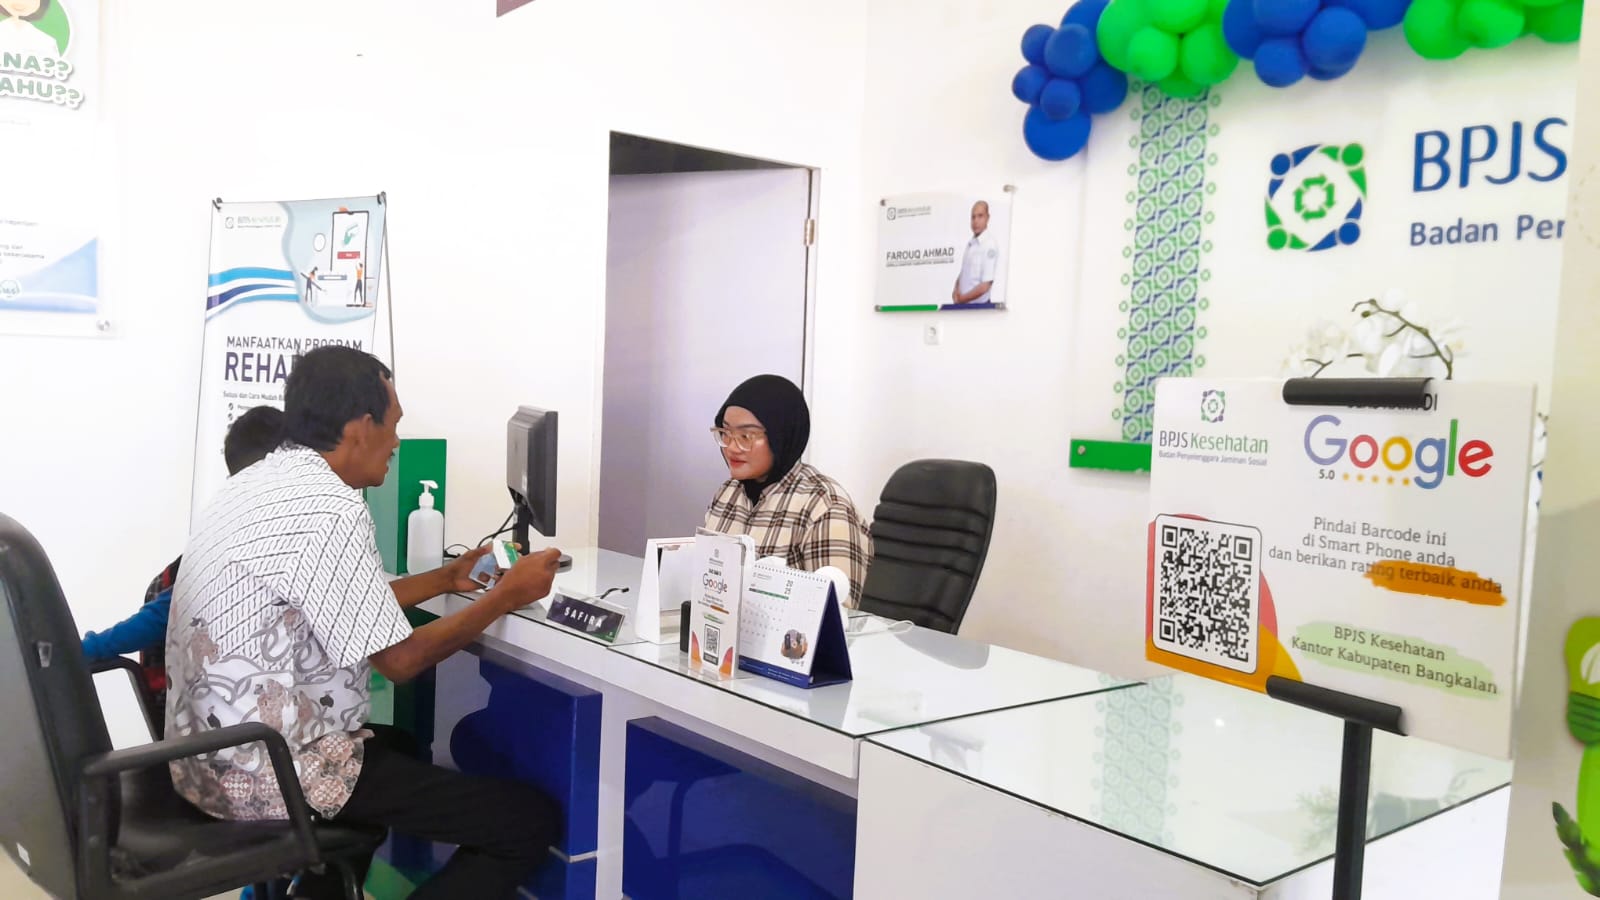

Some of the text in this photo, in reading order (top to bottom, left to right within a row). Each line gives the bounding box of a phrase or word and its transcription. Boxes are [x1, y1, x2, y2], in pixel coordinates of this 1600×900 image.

[0, 51, 69, 77] NA??
[1413, 117, 1568, 192] BPJS
[1410, 217, 1498, 246] Badan
[886, 246, 955, 261] FAROUQ AHMAD
[226, 335, 302, 350] MANFAATKAN
[224, 351, 301, 383] REHA
[1160, 430, 1268, 454] BPJS Kesehatan
[1304, 414, 1494, 489] Google
[1319, 469, 1336, 480] 5.0
[1313, 517, 1447, 546] Pindai Barcode ini
[1302, 533, 1456, 567] di Smart Phone anda
[702, 573, 728, 594] Google
[1268, 545, 1503, 595] dan berikan rating terbaik anda
[564, 606, 603, 628] SAFIRA
[1334, 626, 1446, 661] BPJS Kesehatan
[1292, 636, 1498, 695] Kantor Kabupaten Bangkalan
